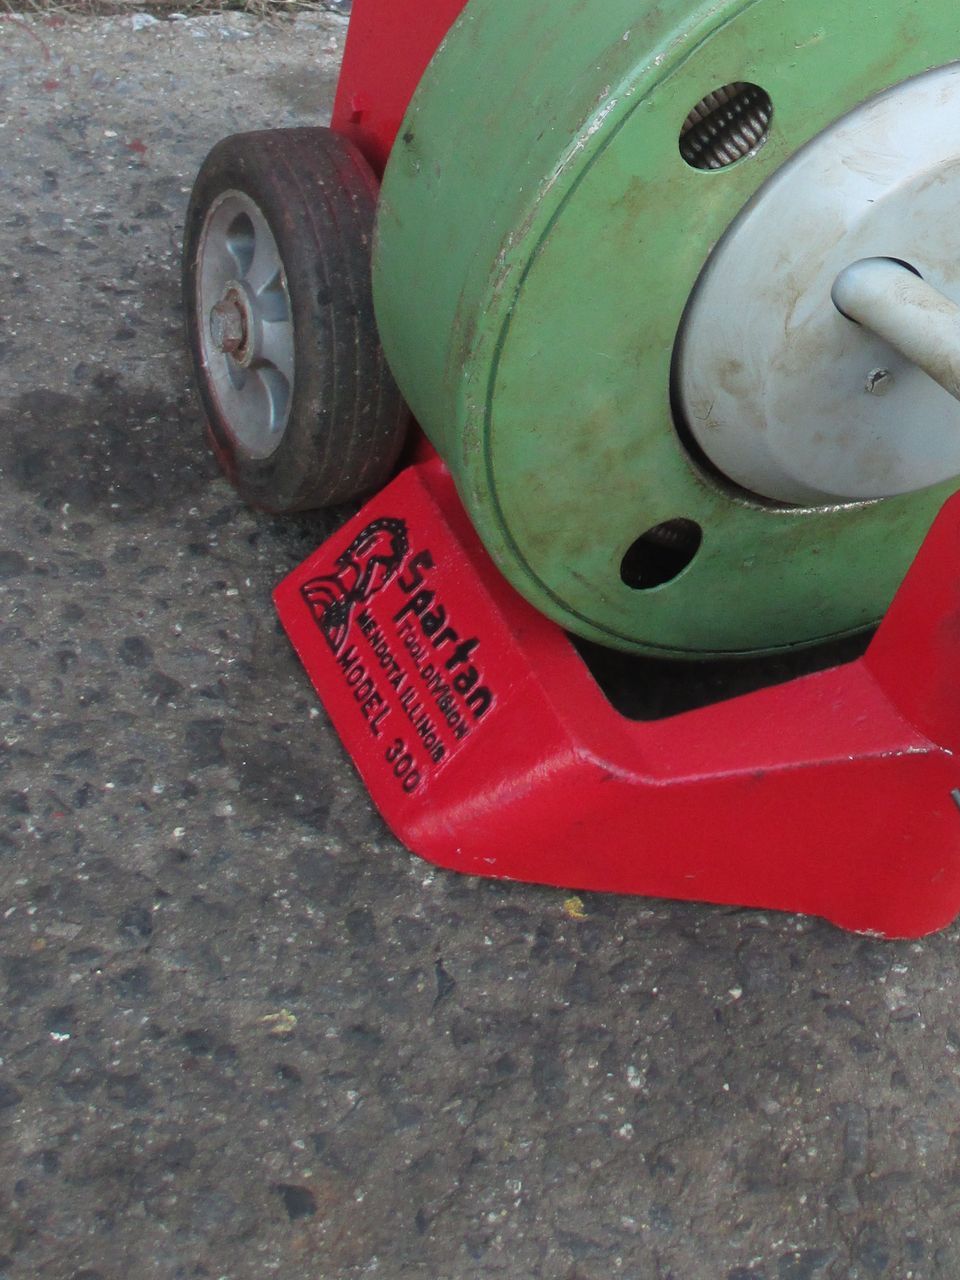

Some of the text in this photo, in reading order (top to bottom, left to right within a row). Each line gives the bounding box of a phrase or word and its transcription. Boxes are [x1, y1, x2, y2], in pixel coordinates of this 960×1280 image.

[355, 608, 447, 763] MENDOTA ILLINOIS
[393, 549, 496, 719] Spartan
[420, 662, 470, 741] DIVISION
[338, 645, 422, 793] MODEL 300
